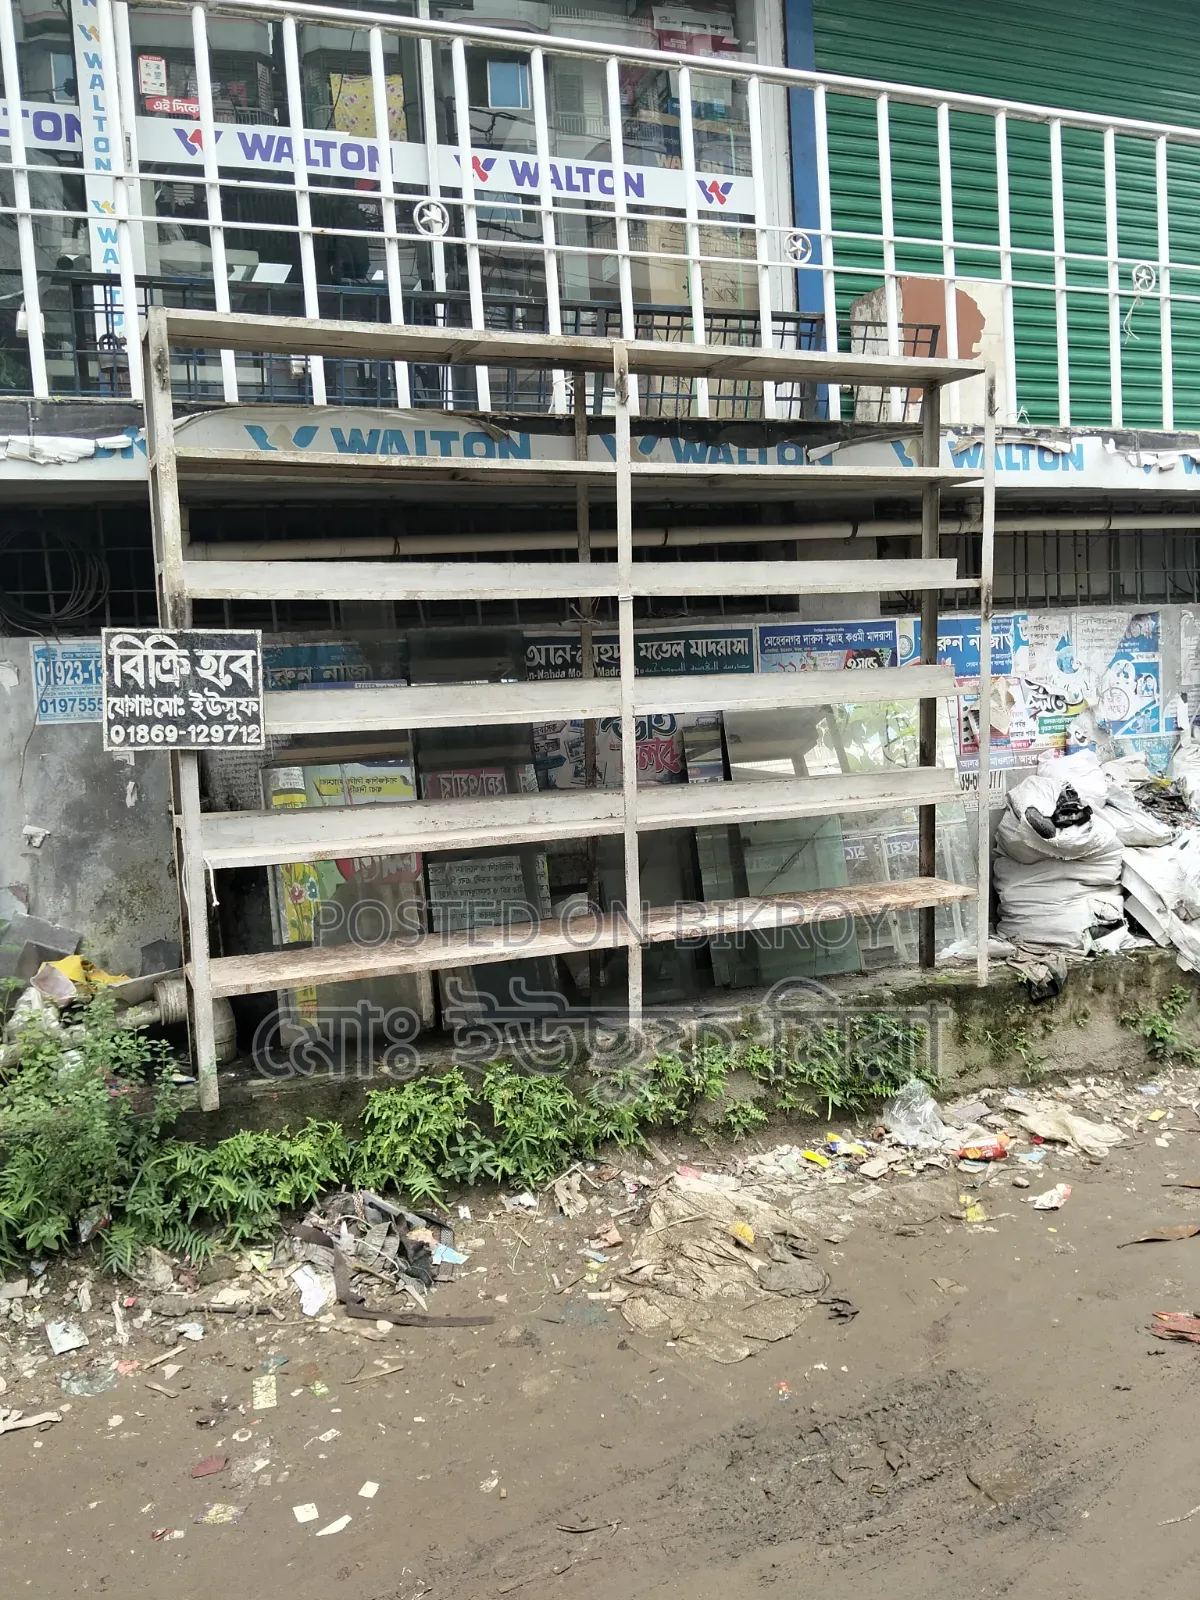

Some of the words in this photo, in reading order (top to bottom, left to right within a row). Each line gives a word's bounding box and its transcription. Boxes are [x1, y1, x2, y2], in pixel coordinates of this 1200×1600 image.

[153, 98, 171, 112] এই
[0, 107, 82, 143] ON
[236, 131, 394, 175] WALTON
[508, 159, 645, 198] WALTON
[689, 637, 749, 657] মাদরাসা
[108, 634, 190, 689] বিক্রি
[194, 649, 256, 691] হবে
[527, 668, 566, 681] n-Nahda
[110, 724, 261, 744] 01869-129712
